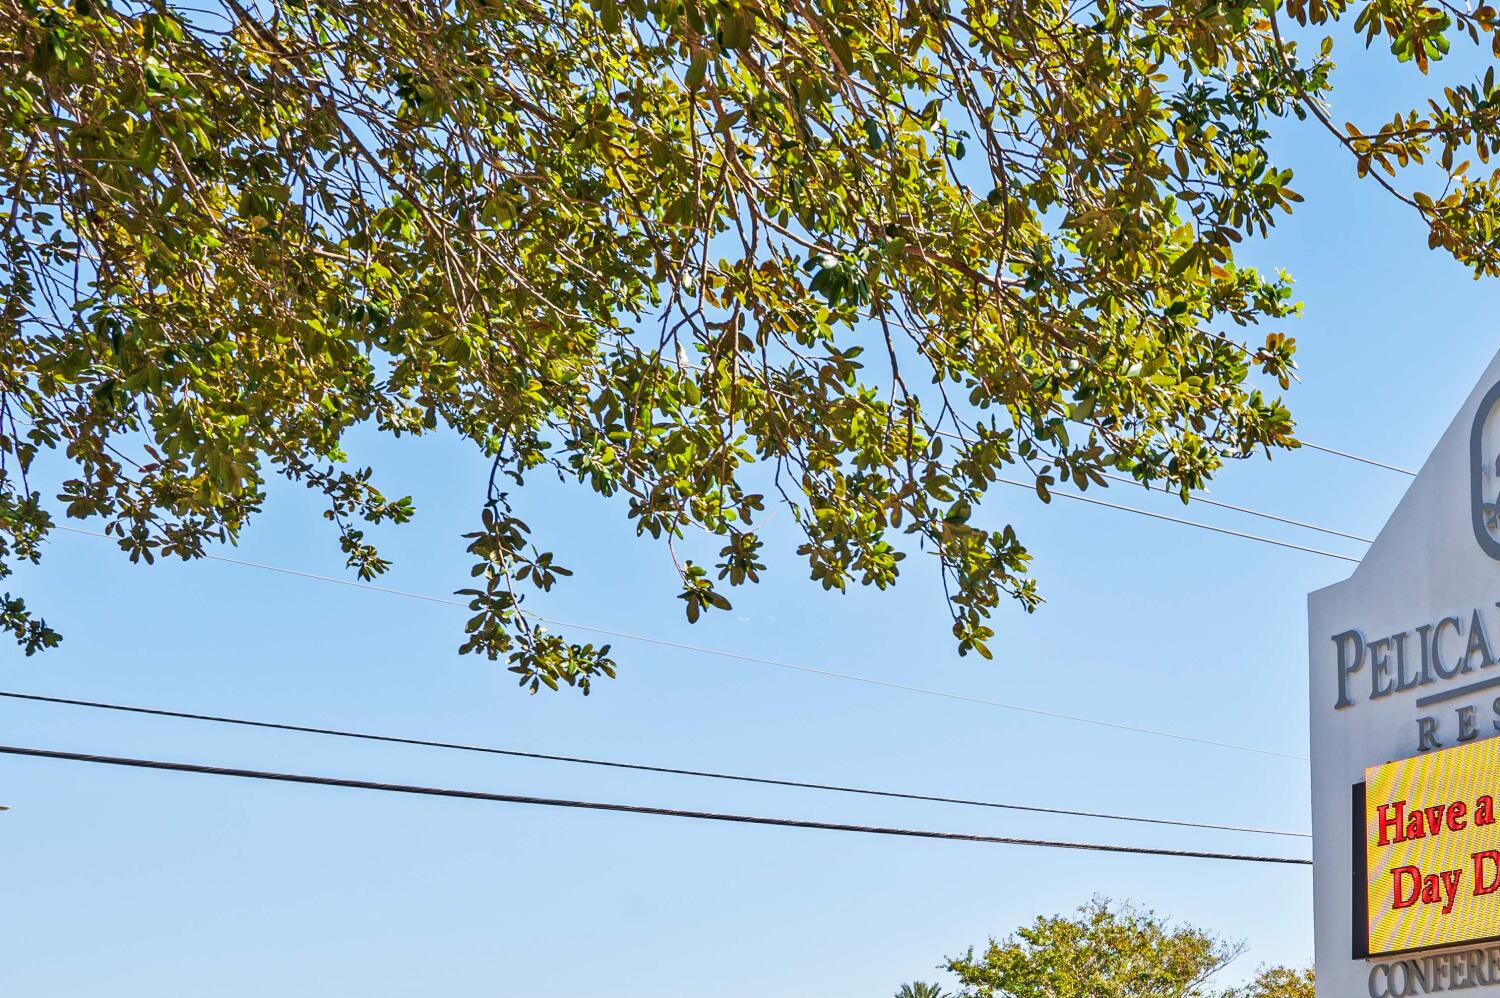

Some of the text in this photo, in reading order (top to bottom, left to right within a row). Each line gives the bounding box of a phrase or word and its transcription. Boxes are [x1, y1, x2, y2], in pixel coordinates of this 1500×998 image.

[1376, 800, 1468, 847] Have
[1474, 795, 1495, 827] a
[1390, 864, 1463, 915] Day
